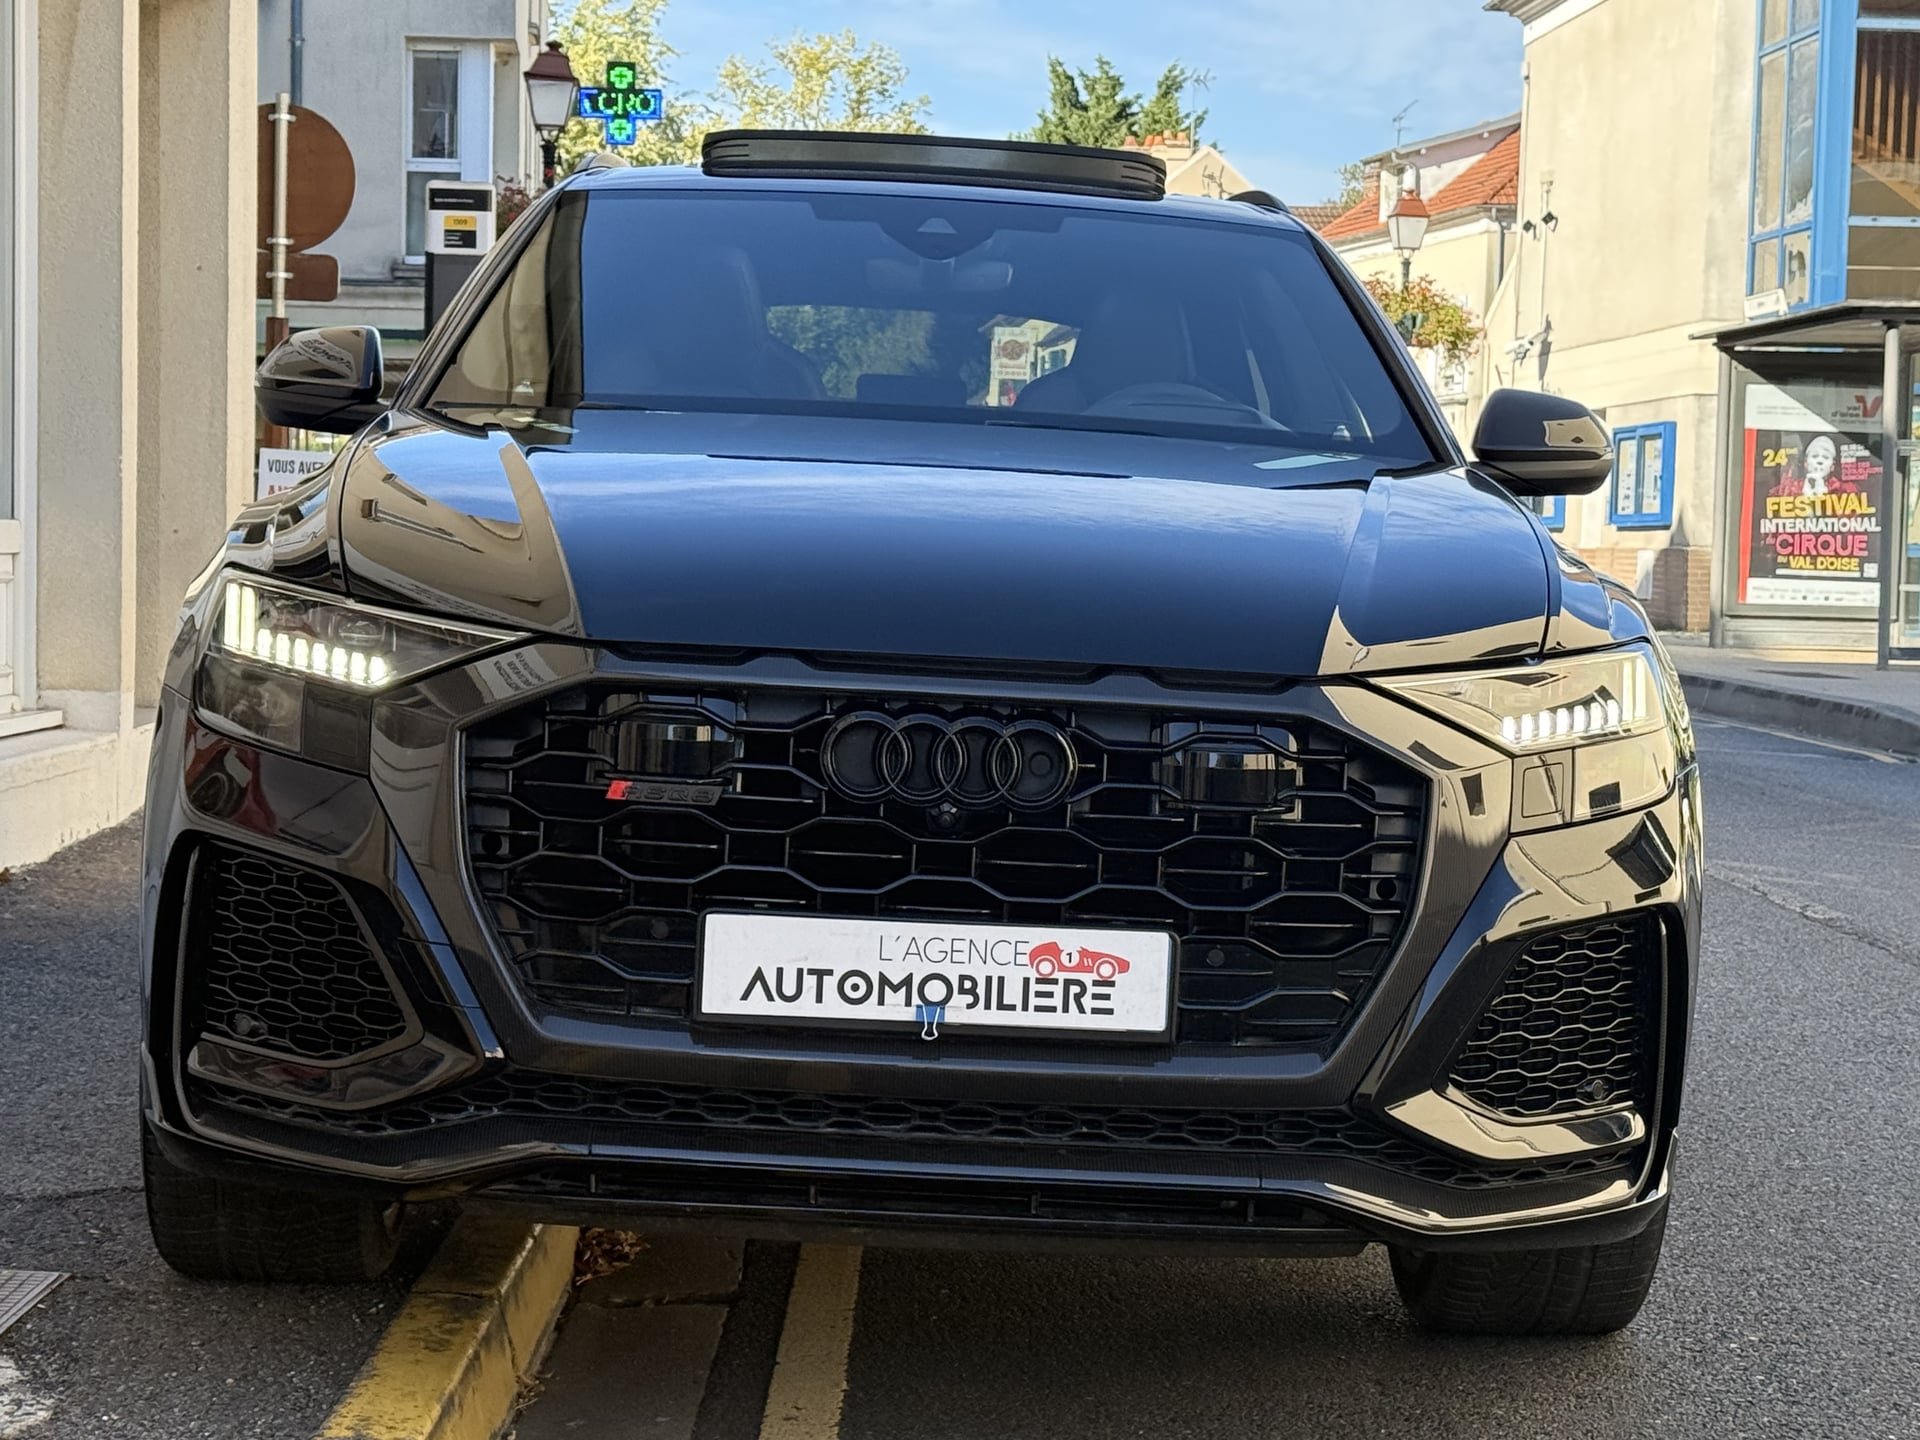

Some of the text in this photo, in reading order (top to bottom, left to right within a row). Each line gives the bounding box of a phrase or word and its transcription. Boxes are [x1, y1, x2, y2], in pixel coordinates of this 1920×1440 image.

[268, 459, 296, 474] VOUS
[1766, 492, 1876, 518] FESTIVAL
[1760, 517, 1882, 533] INTERNATIONAL
[1776, 534, 1869, 556] CIRQUE
[1789, 556, 1815, 569] VAL
[1816, 556, 1860, 571] D'OISE
[879, 935, 1030, 967] L'AGENCE
[1066, 951, 1073, 964] 1
[739, 966, 1116, 1016] AUTOMOBILIERE
